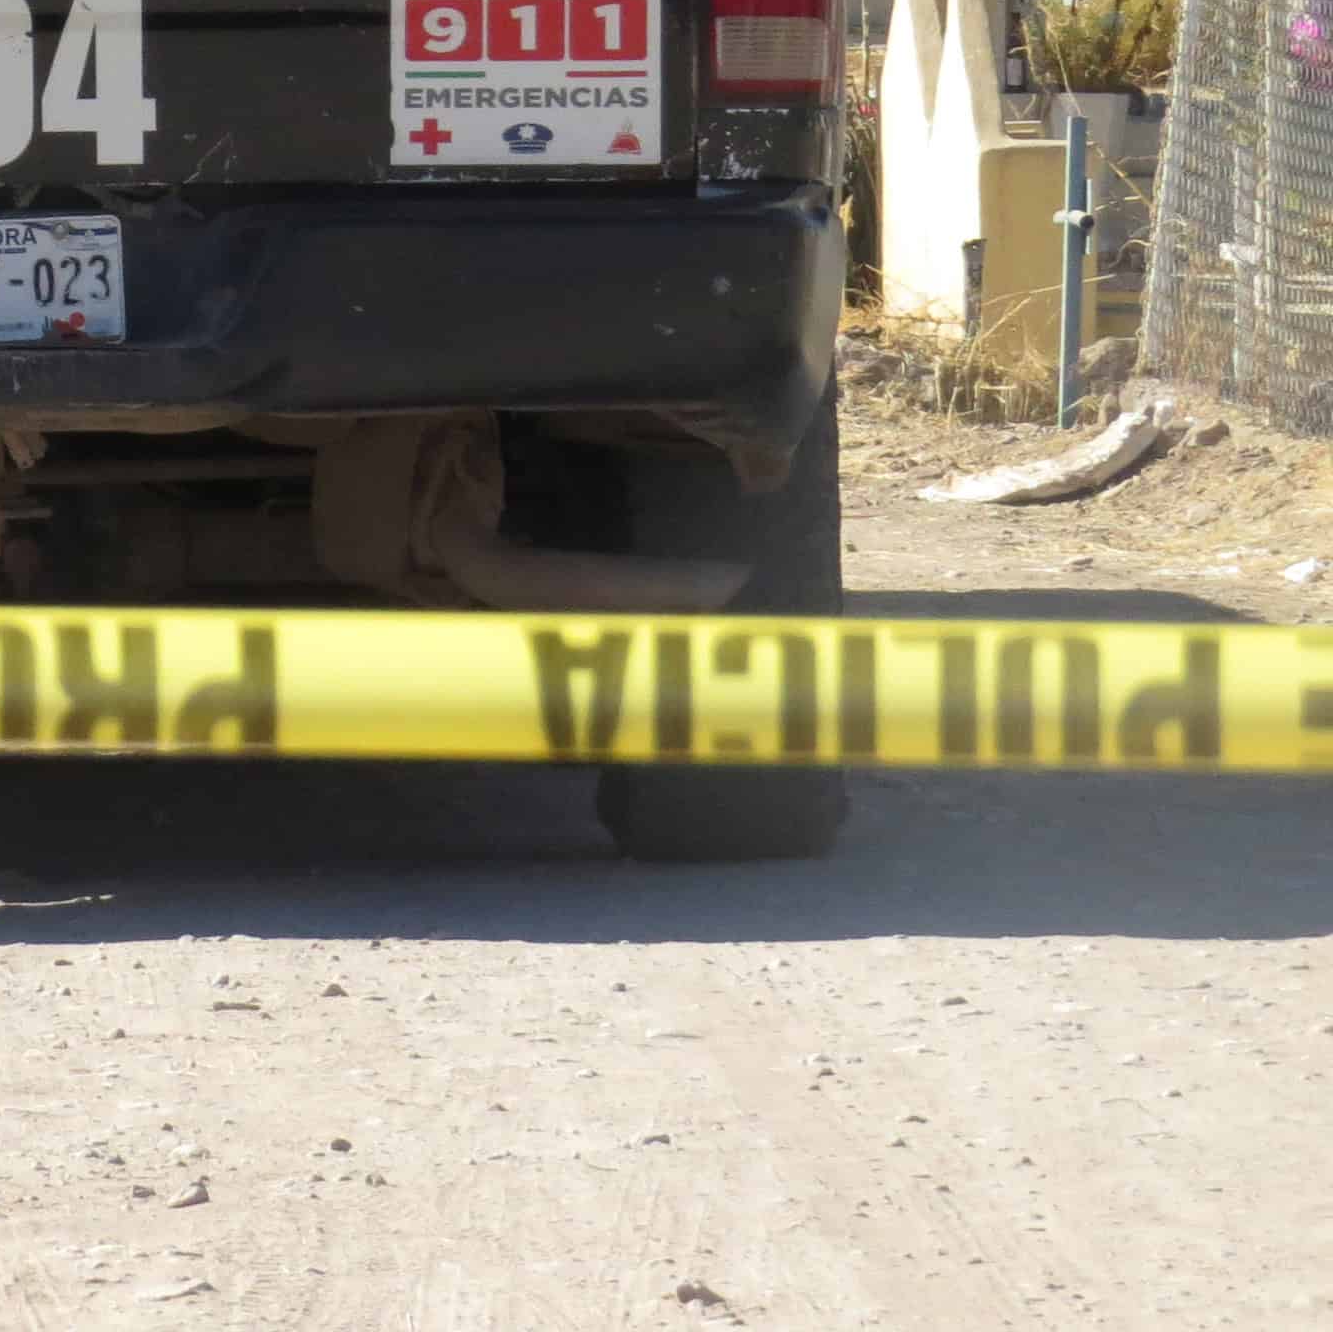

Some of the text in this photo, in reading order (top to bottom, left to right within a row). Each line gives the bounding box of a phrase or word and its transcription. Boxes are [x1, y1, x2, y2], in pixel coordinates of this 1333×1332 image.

[422, 3, 622, 55] 911
[404, 87, 650, 110] EMERGENCIAS
[528, 626, 1221, 760] POLICIA
